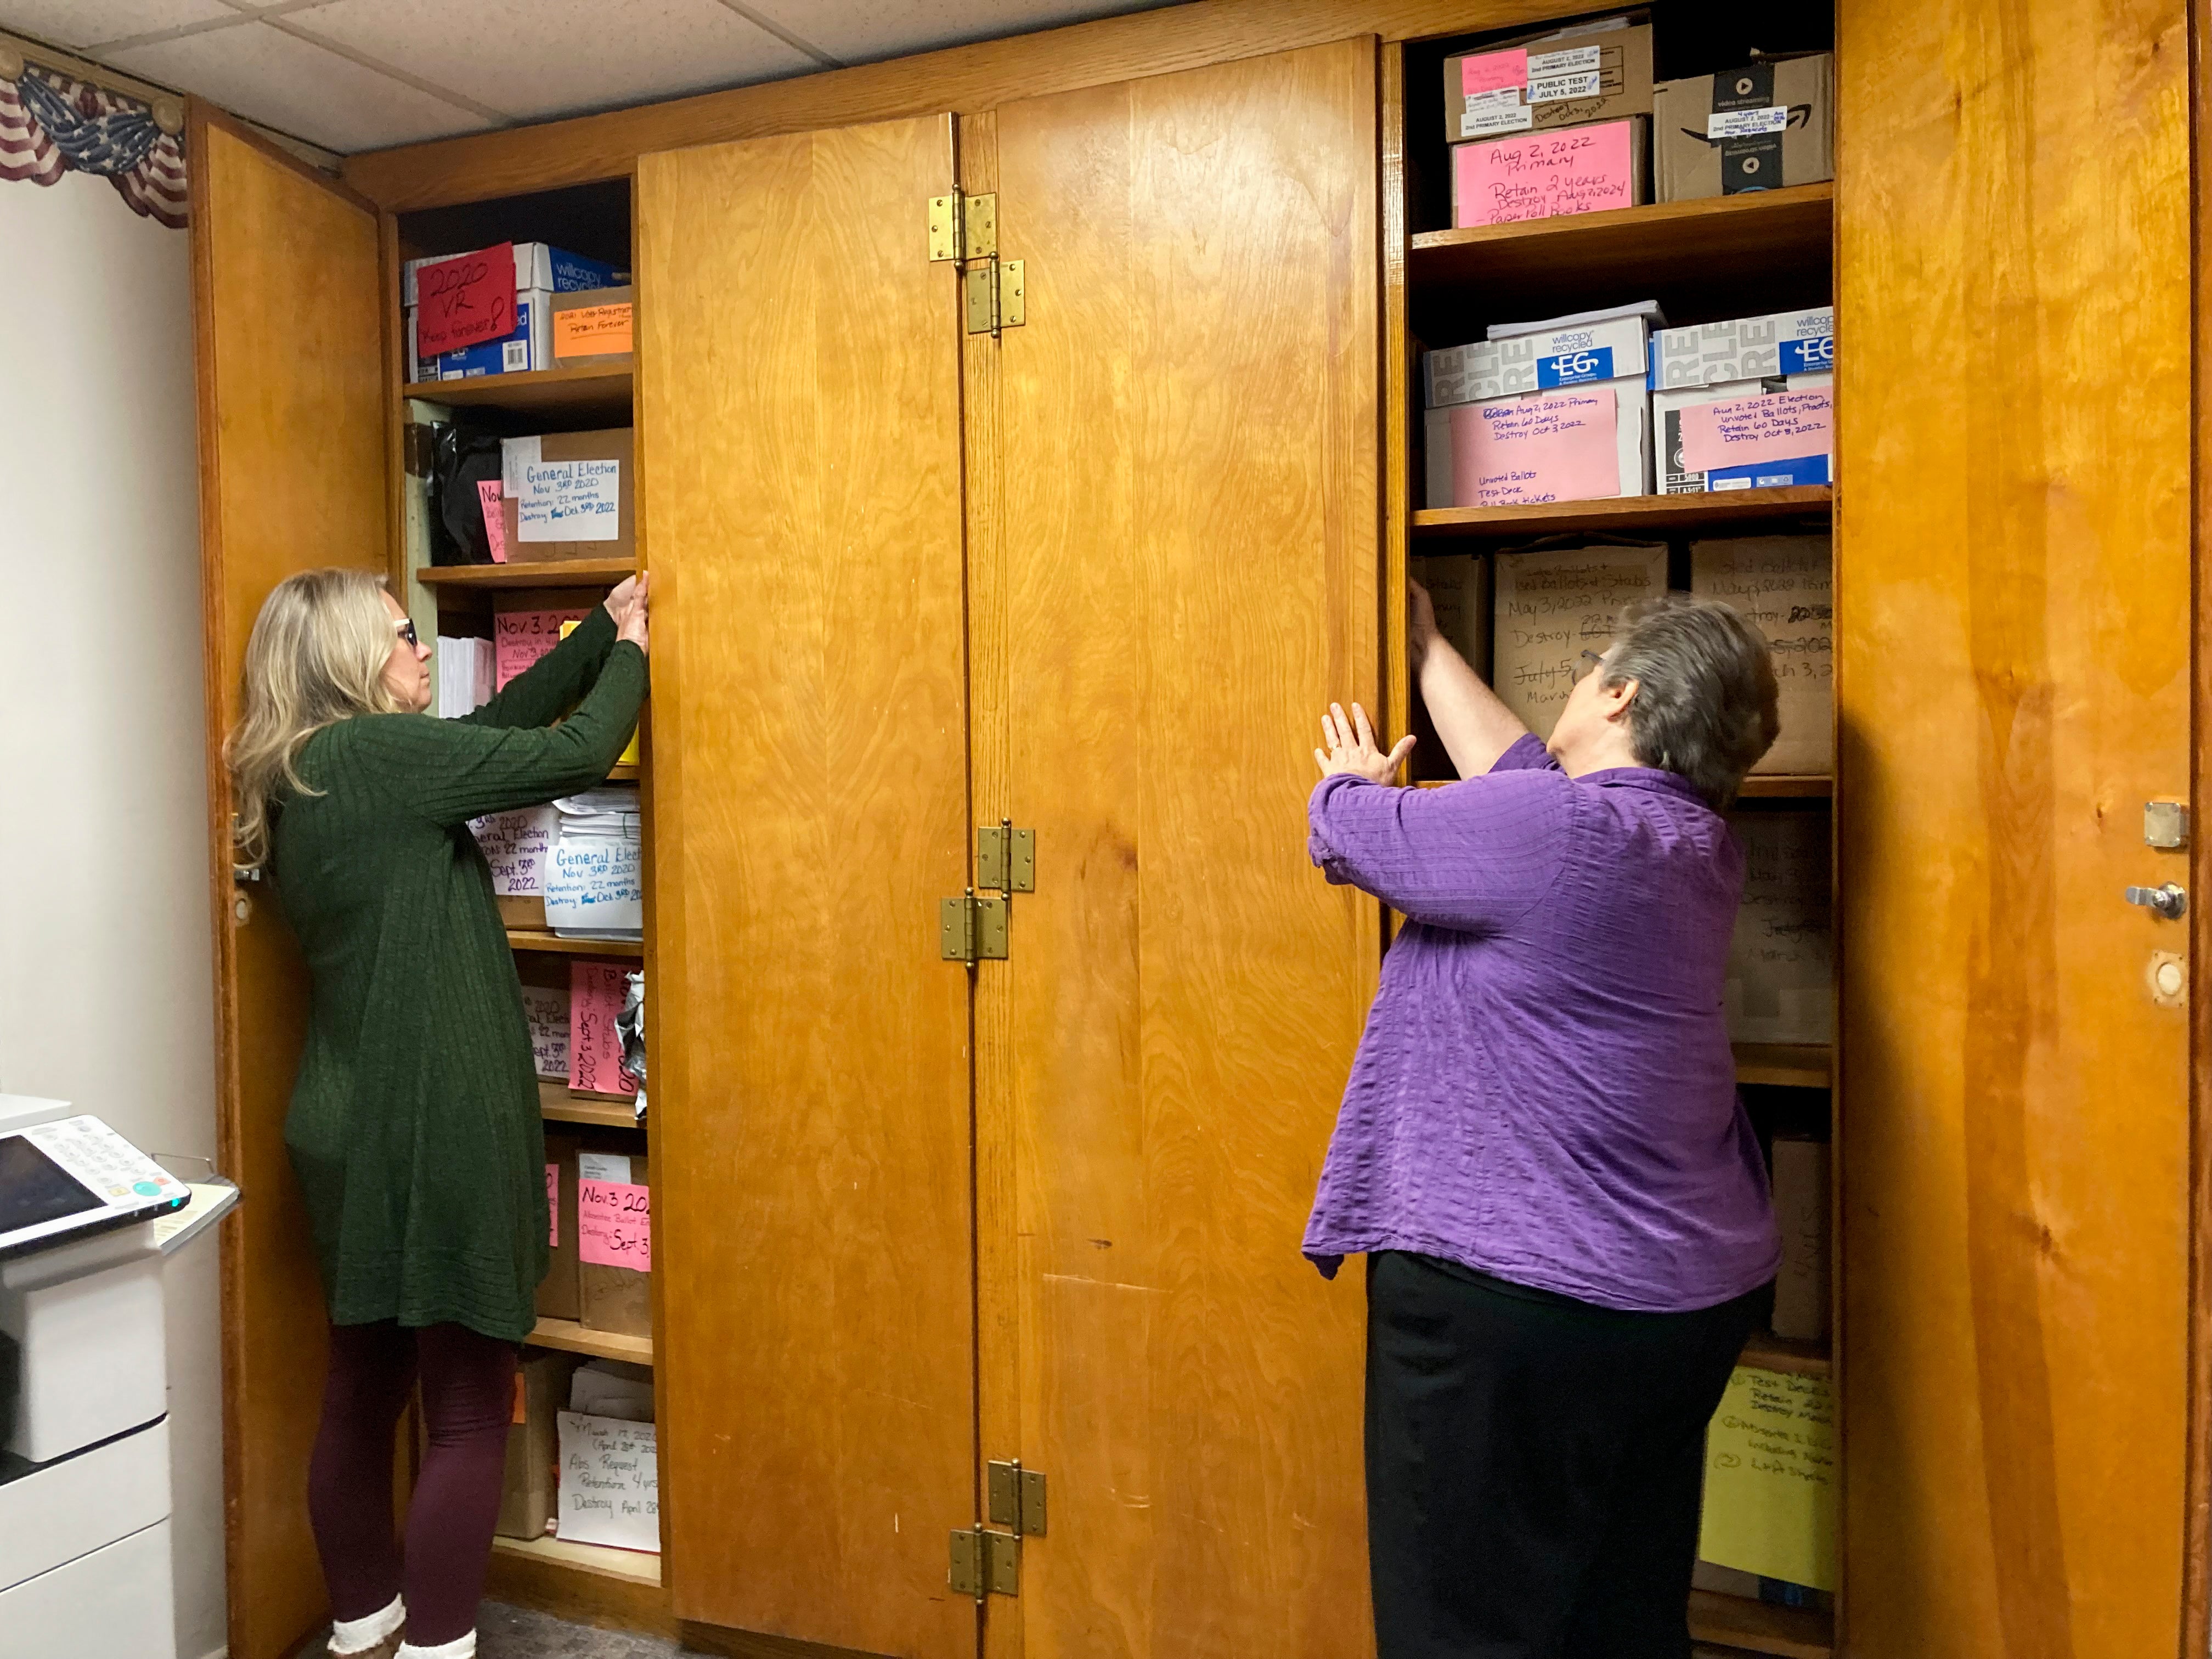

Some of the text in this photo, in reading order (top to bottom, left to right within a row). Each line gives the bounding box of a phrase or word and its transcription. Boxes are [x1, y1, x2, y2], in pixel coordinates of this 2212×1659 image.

[1542, 63, 1566, 71] PRIMARY
[1537, 76, 1588, 89] PUBLIC TEST
[1539, 89, 1558, 98] JULY
[1491, 137, 1598, 164] Aug 2, 2022
[1506, 155, 1573, 176] Primary
[1488, 174, 1607, 199] Retain 2 years
[1498, 195, 1546, 211] Destroy
[442, 290, 473, 318] VR
[1552, 331, 1593, 345] willcopy
[1797, 324, 1833, 337] recycle
[1552, 339, 1593, 353] recycled
[1550, 351, 1599, 377] EG
[1516, 405, 1533, 416] Aug
[1543, 402, 1567, 410] 2022
[1747, 399, 1775, 409] 2022
[1494, 431, 1528, 441] Destroy
[1533, 427, 1550, 435] Oct
[1560, 421, 1586, 430] 2022
[1718, 417, 1798, 433] Retain 60 Days
[1723, 423, 1826, 442] Destroy Oct 2022
[527, 462, 616, 483] General Election
[533, 484, 550, 495] Nov
[575, 478, 599, 488] 2020
[557, 495, 571, 505] 22
[572, 492, 600, 502] months
[1479, 490, 1499, 499] Test
[595, 502, 616, 515] 2022
[475, 826, 549, 842] neral Election
[556, 848, 610, 866] General
[563, 869, 584, 878] Nov
[612, 865, 635, 875] 2020
[508, 878, 539, 891] 2022
[591, 881, 605, 889] 22
[606, 878, 636, 888] months
[614, 1214, 636, 1225] Ballot
[632, 1471, 643, 1489] 4
[571, 1493, 614, 1519] Destroy
